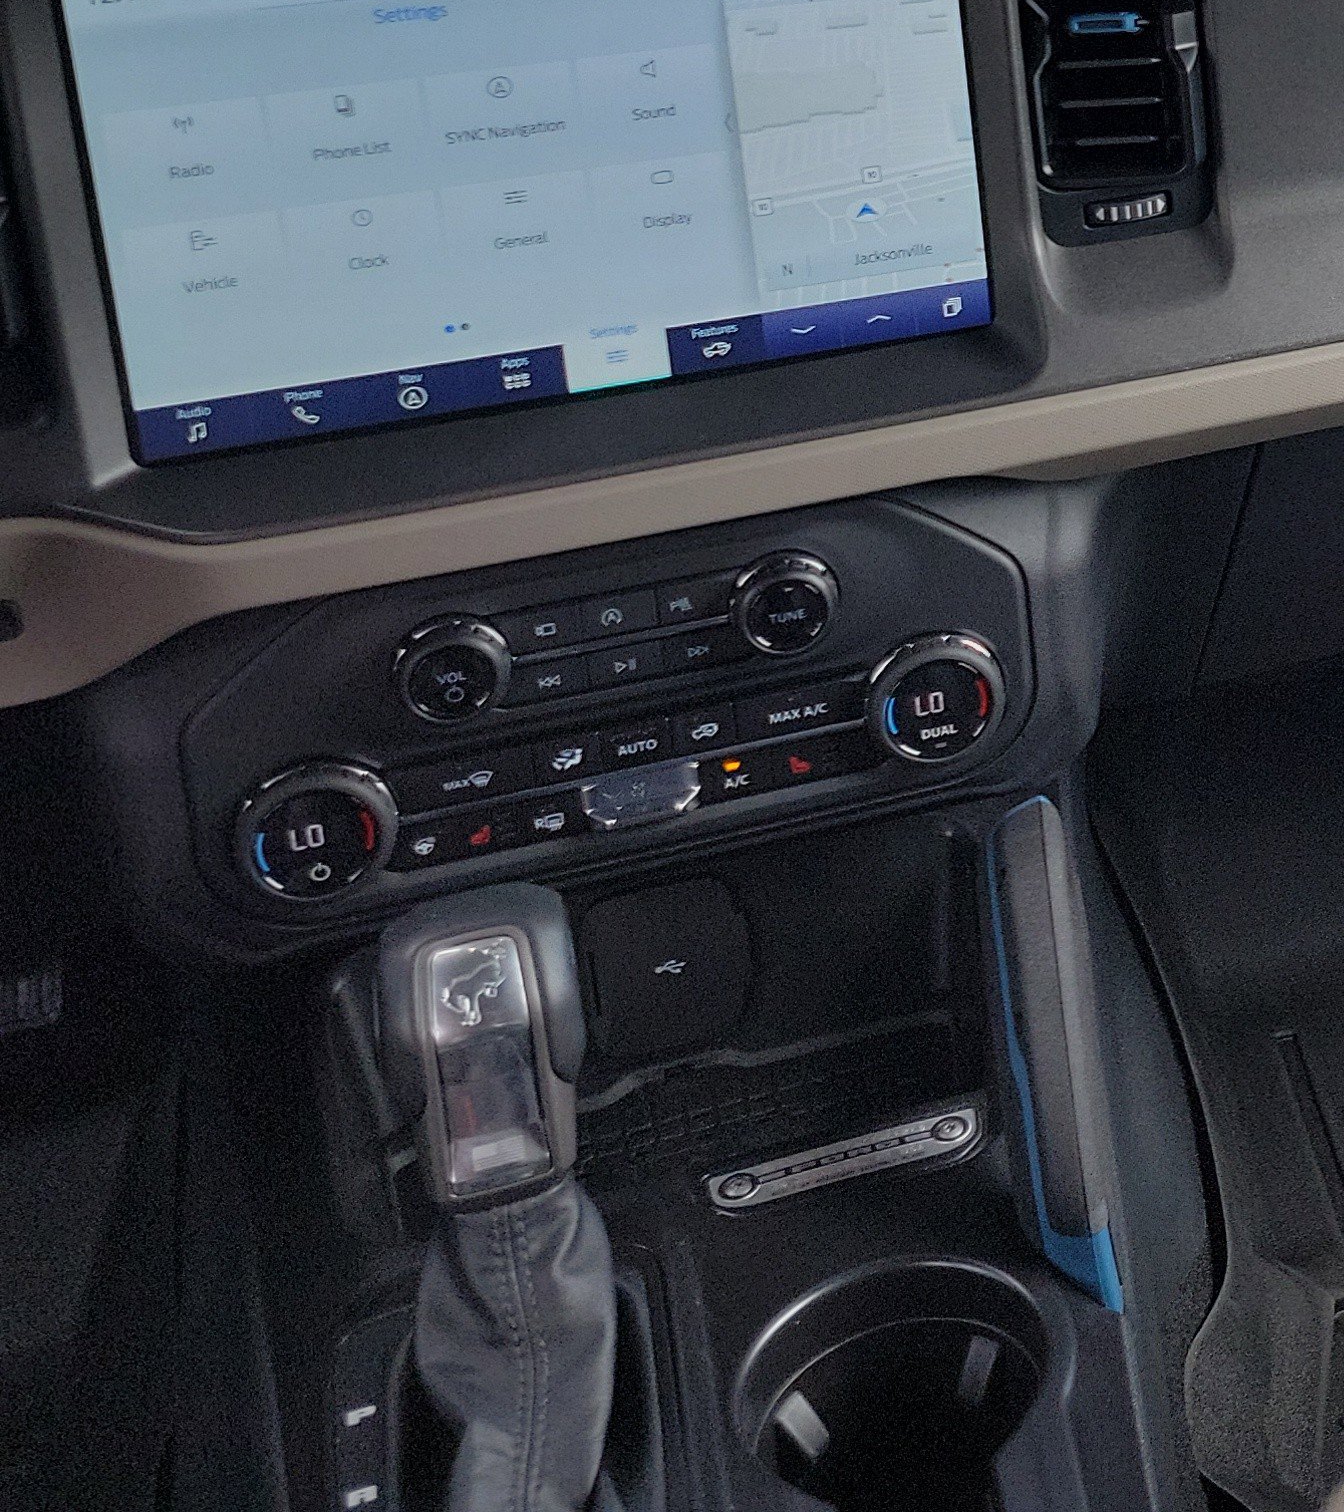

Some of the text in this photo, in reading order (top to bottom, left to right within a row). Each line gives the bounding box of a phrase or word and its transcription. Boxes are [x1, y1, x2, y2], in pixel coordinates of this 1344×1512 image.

[373, 4, 449, 23] Settings
[631, 105, 677, 121] Sound
[445, 120, 567, 145] SYNC Navigation
[312, 141, 393, 161] Phone List
[169, 163, 215, 178] Radio
[643, 212, 693, 229] Display
[494, 231, 549, 249] General
[348, 254, 389, 270] Clock
[854, 242, 934, 266] Jacksonville
[182, 276, 239, 293] Vehicle
[691, 323, 740, 340] Features
[501, 356, 531, 370] Apps
[283, 388, 324, 403] Phone
[175, 405, 213, 420] Audio
[768, 607, 808, 624] TUNE
[435, 670, 468, 686] VOL
[913, 690, 945, 717] LO
[768, 702, 829, 725] MAX A/C
[920, 723, 959, 741] DUAL
[617, 738, 659, 756] AUTO
[723, 773, 750, 789] A/C
[288, 822, 326, 852] LO
[345, 1404, 377, 1427] P
[345, 1485, 378, 1508] R
